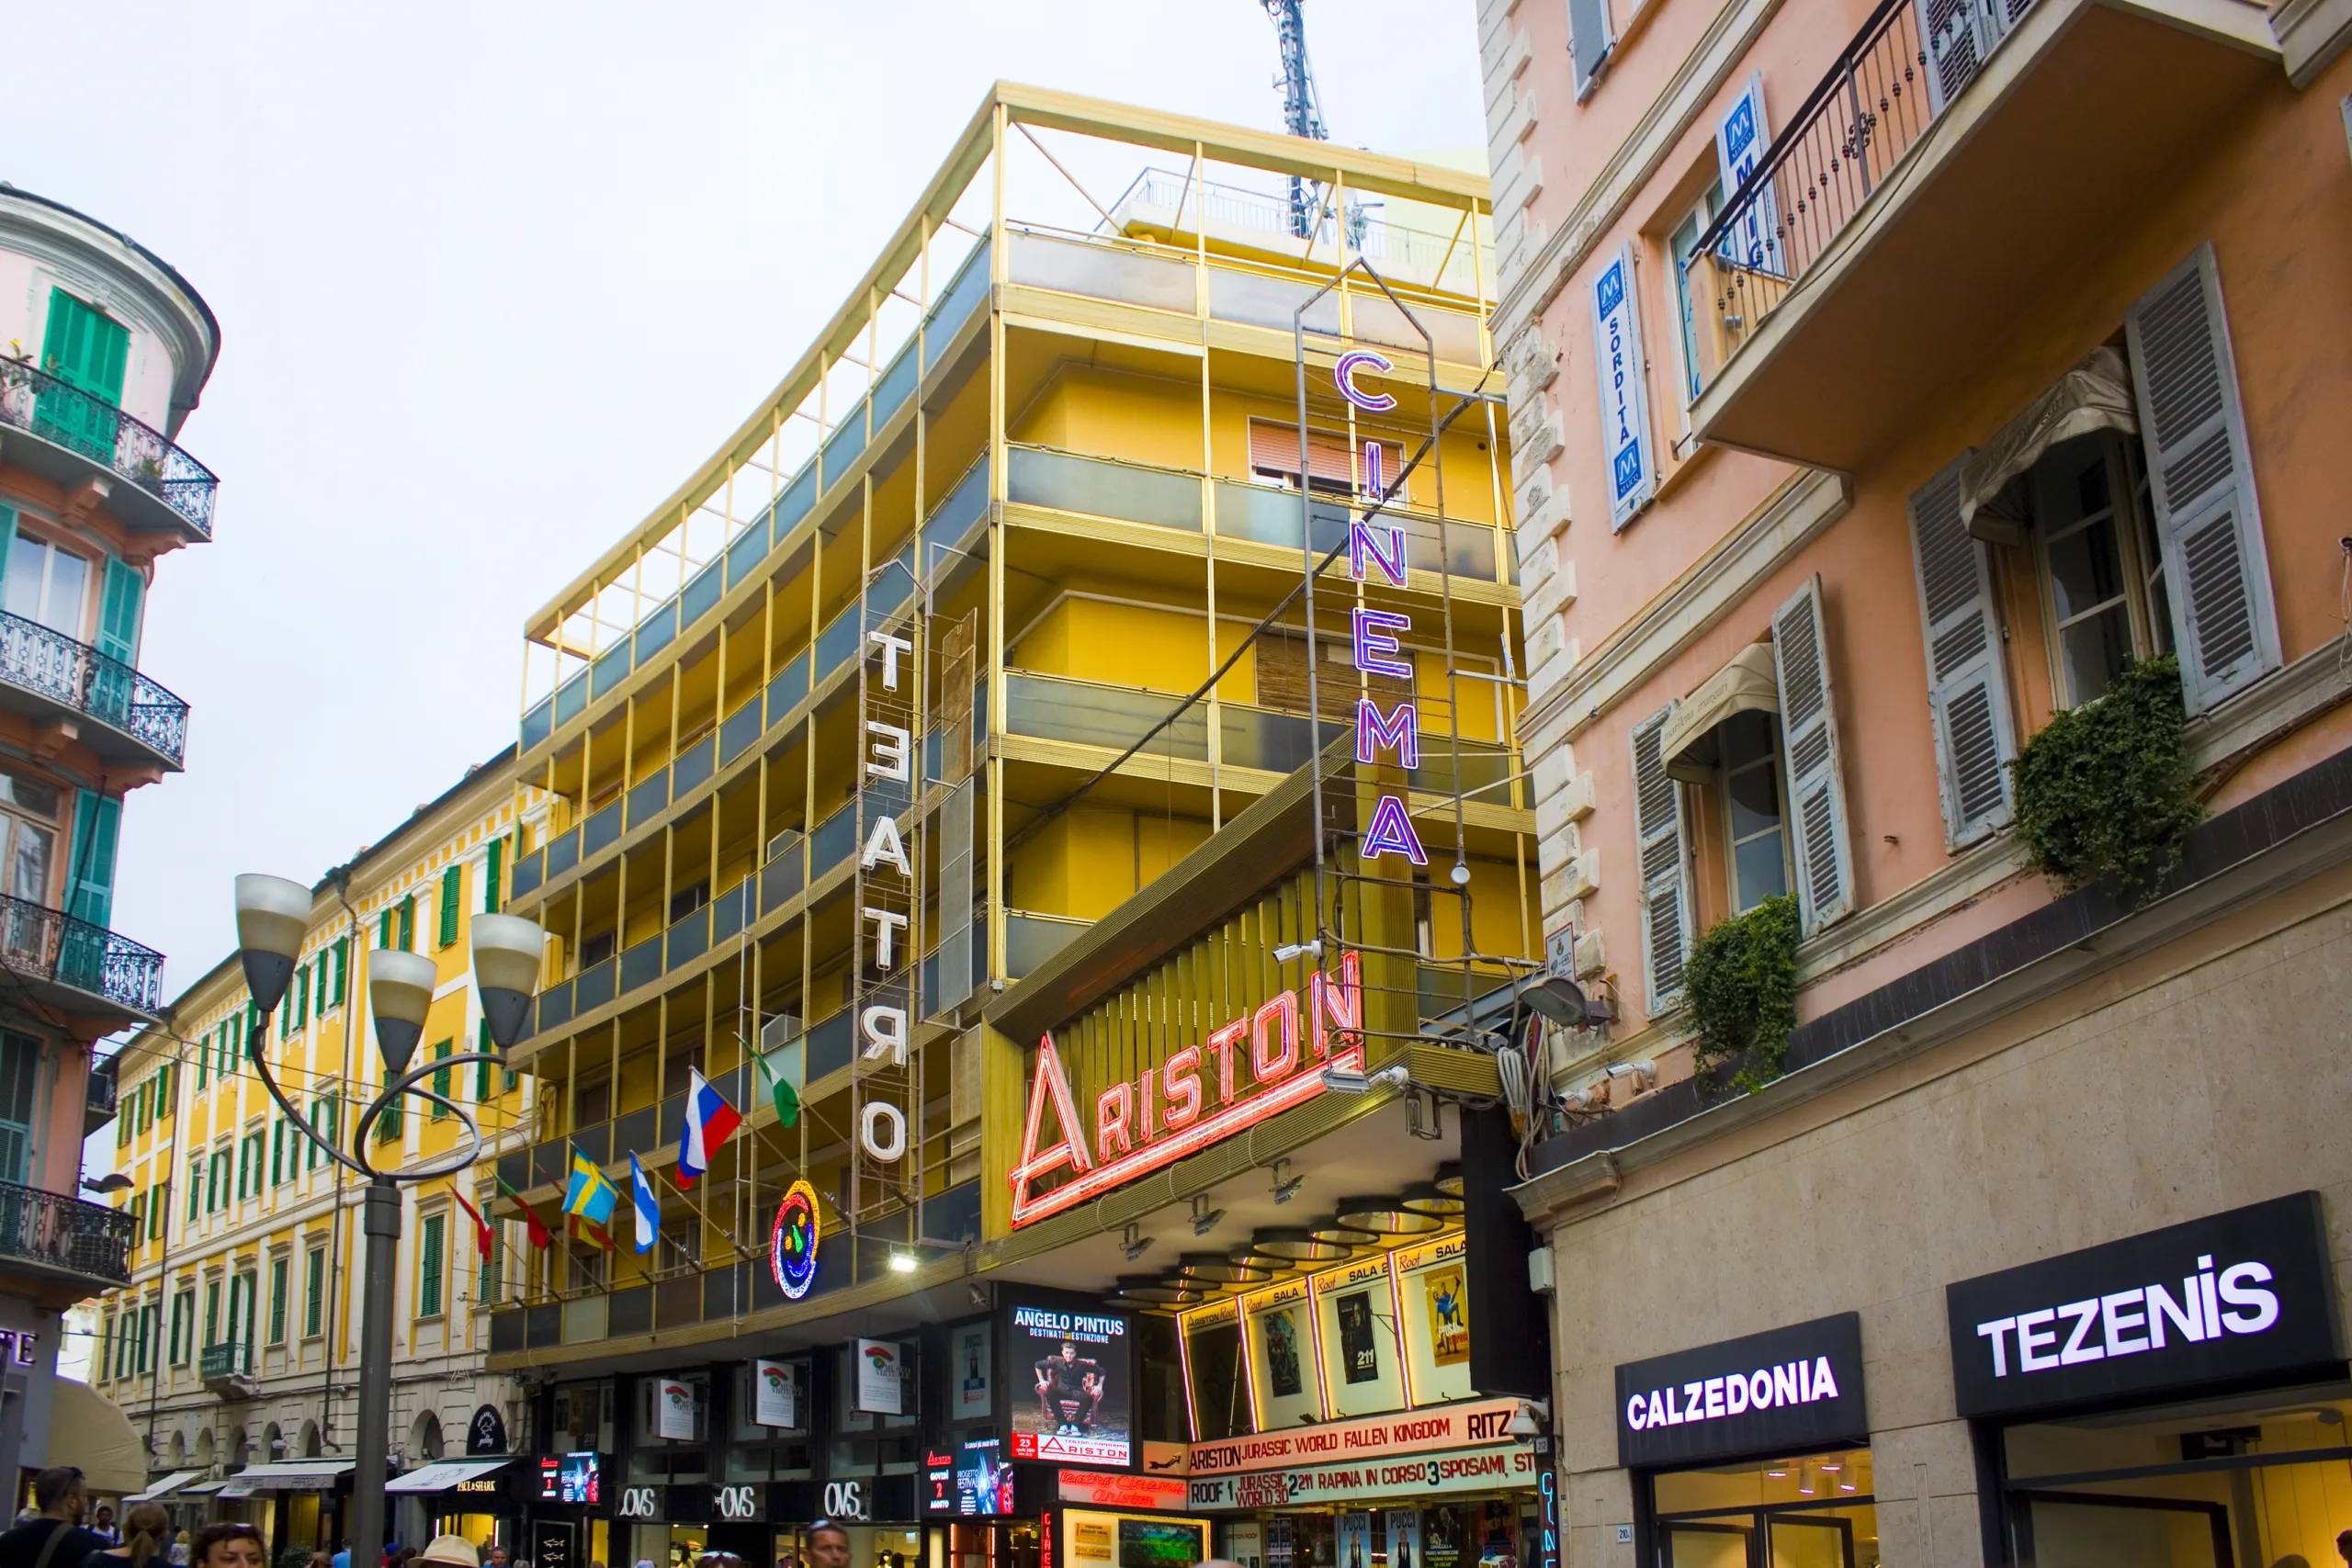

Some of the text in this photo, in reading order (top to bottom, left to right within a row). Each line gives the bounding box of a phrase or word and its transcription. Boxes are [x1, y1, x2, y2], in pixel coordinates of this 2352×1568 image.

[1334, 349, 1429, 865] CINEMA
[1009, 949, 1364, 1229] ARISTON
[1399, 1249, 1423, 1269] Roof
[1317, 1273, 1338, 1292] Roof
[1349, 1266, 1378, 1282] SALA
[1245, 1295, 1264, 1312] Roof
[1273, 1287, 1299, 1303] SALA
[1014, 1310, 1124, 1336] ANGELO PINTUS
[1220, 1305, 1237, 1323] Roof
[1029, 1327, 1064, 1339] DESTINATI
[1071, 1332, 1109, 1344] ESTINZIONE
[1357, 1348, 1374, 1366] 211
[1626, 1356, 1839, 1431] CALZEDONIA
[1020, 1438, 1031, 1448] 23
[1040, 1436, 1127, 1458] ARISTON
[1189, 1410, 1511, 1471] ARISTON JURASSIC WORLD FALLEN KINGDOM RITZ
[1538, 1441, 1546, 1450] 212
[936, 1483, 943, 1498] 2
[1059, 1470, 1185, 1495] Teatro Cinema
[1191, 1452, 1535, 1504] ROOF 1 JURASSIC 2 211 RAPINA IN CORSO 3 SPOSAMI, ST
[623, 1487, 655, 1517] OVS
[720, 1486, 755, 1517] OVS
[824, 1481, 861, 1517] OVS
[1235, 1487, 1289, 1507] WORLD 3D
[1343, 1515, 1366, 1531] PUCCI
[1390, 1511, 1416, 1529] PUCCI
